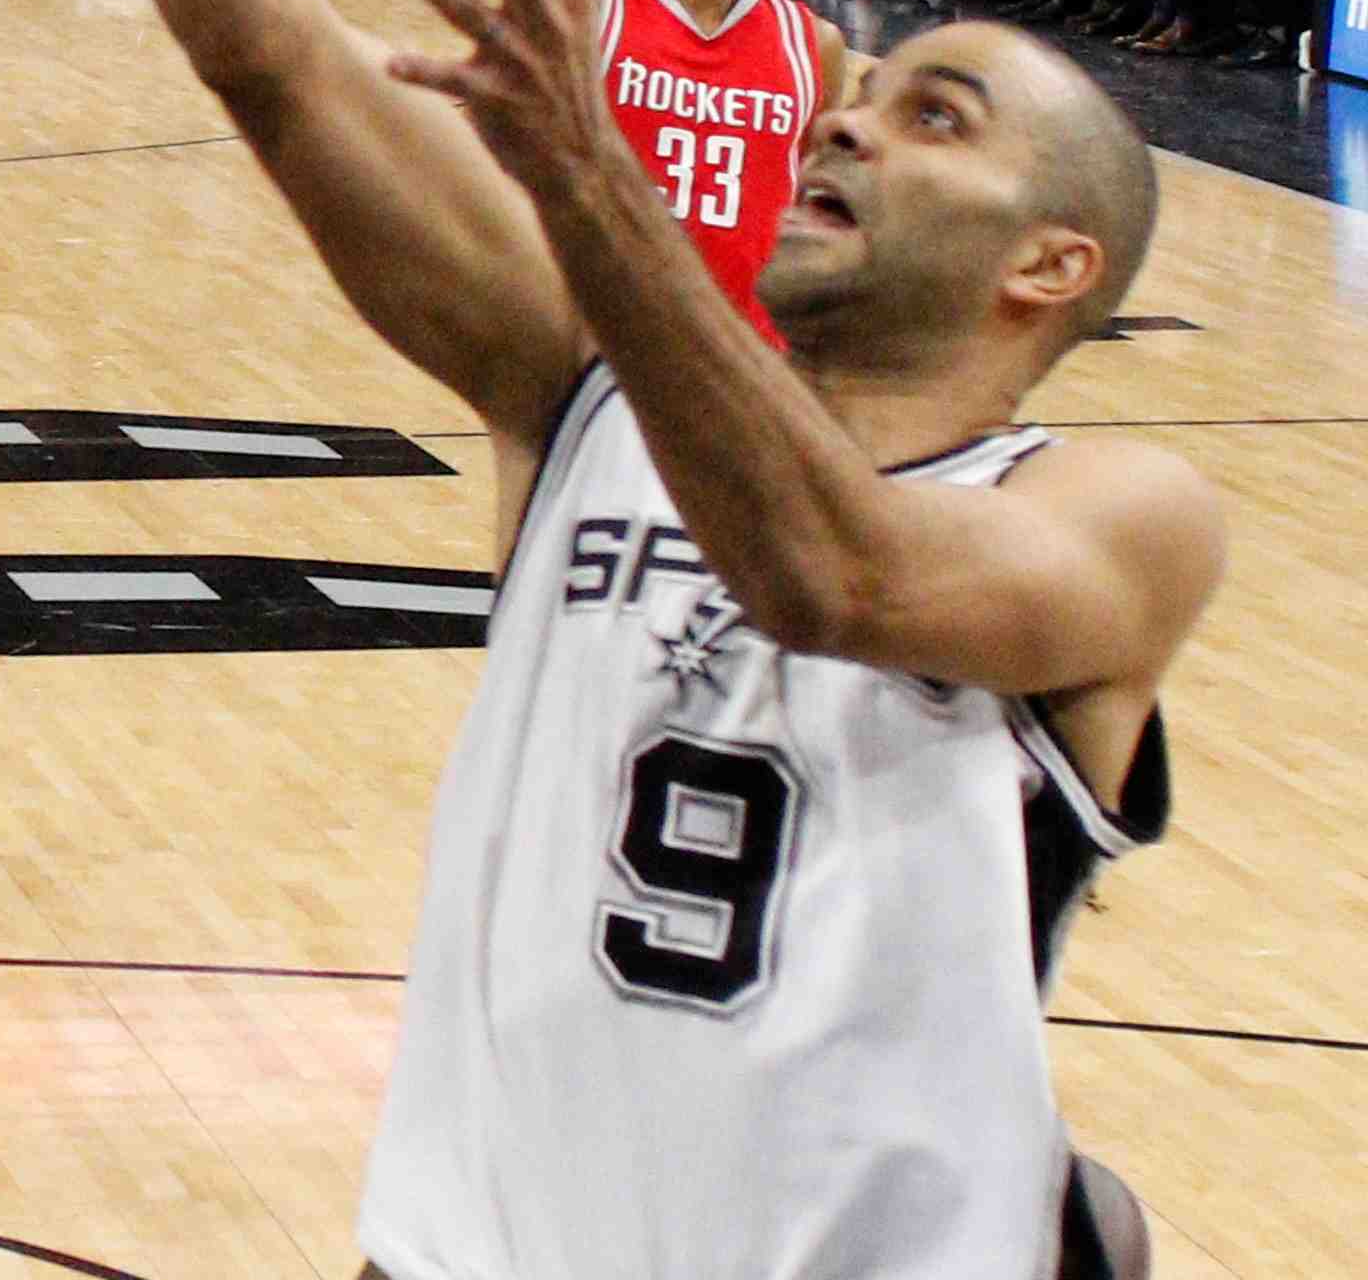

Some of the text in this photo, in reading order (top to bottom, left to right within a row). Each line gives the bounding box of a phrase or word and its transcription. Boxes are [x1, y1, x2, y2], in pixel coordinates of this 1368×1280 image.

[616, 55, 795, 136] ROCKETS
[655, 125, 746, 229] 33
[592, 722, 810, 1022] 9
